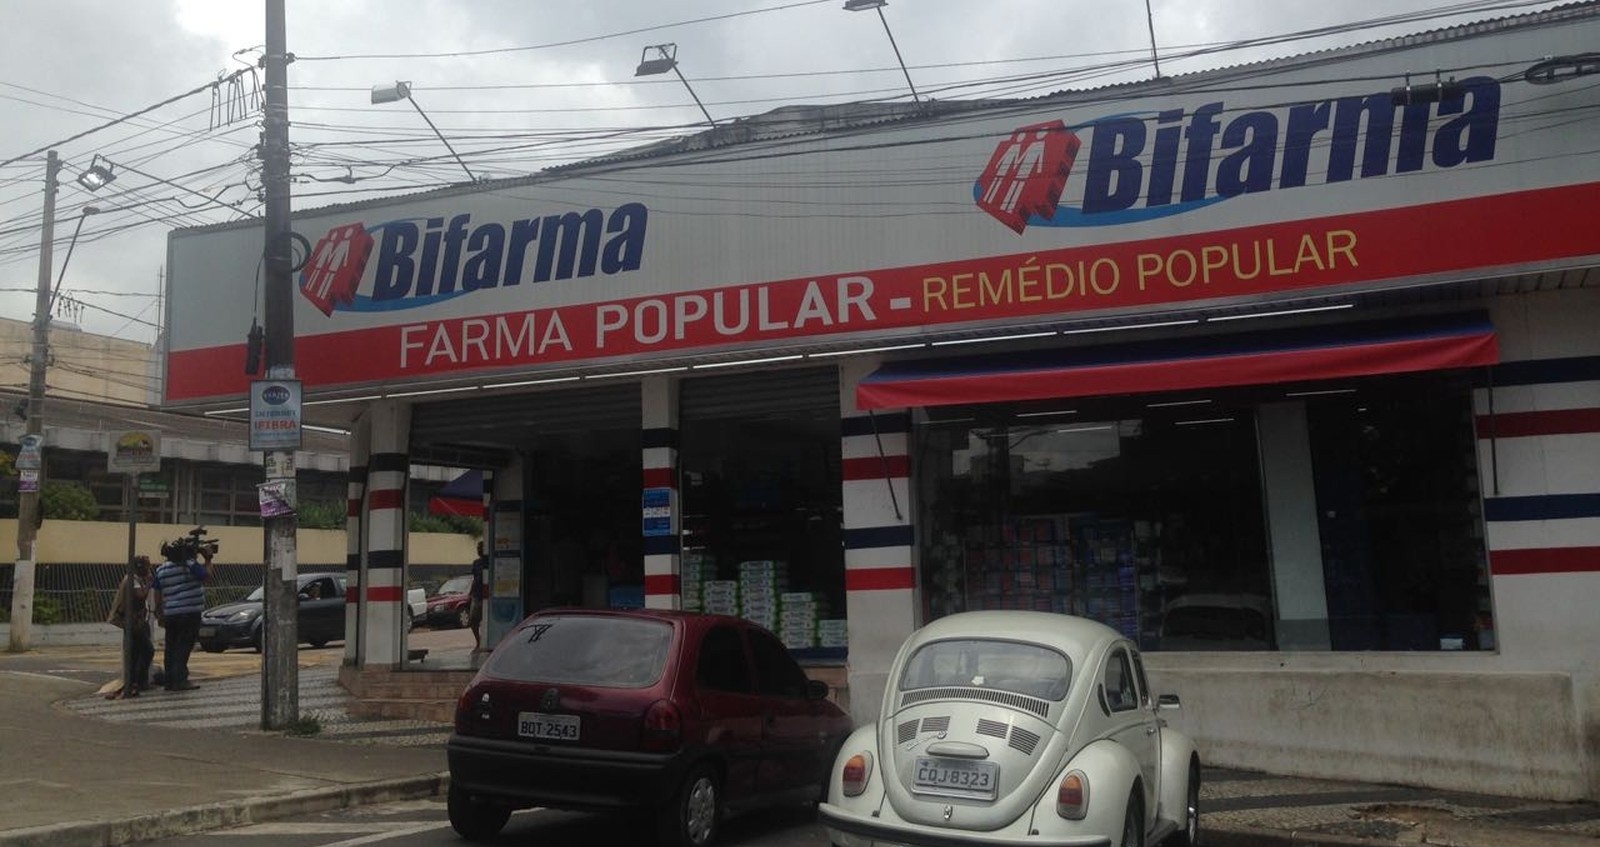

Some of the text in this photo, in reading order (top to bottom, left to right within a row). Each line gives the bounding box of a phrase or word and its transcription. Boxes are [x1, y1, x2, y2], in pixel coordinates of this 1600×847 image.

[1082, 75, 1501, 214] Bifarma
[372, 202, 648, 300] Bifarma
[399, 310, 573, 369] FARMA
[596, 276, 877, 348] POPULAR
[923, 256, 1121, 312] REMÉDIO
[1136, 229, 1360, 291] POPULAR
